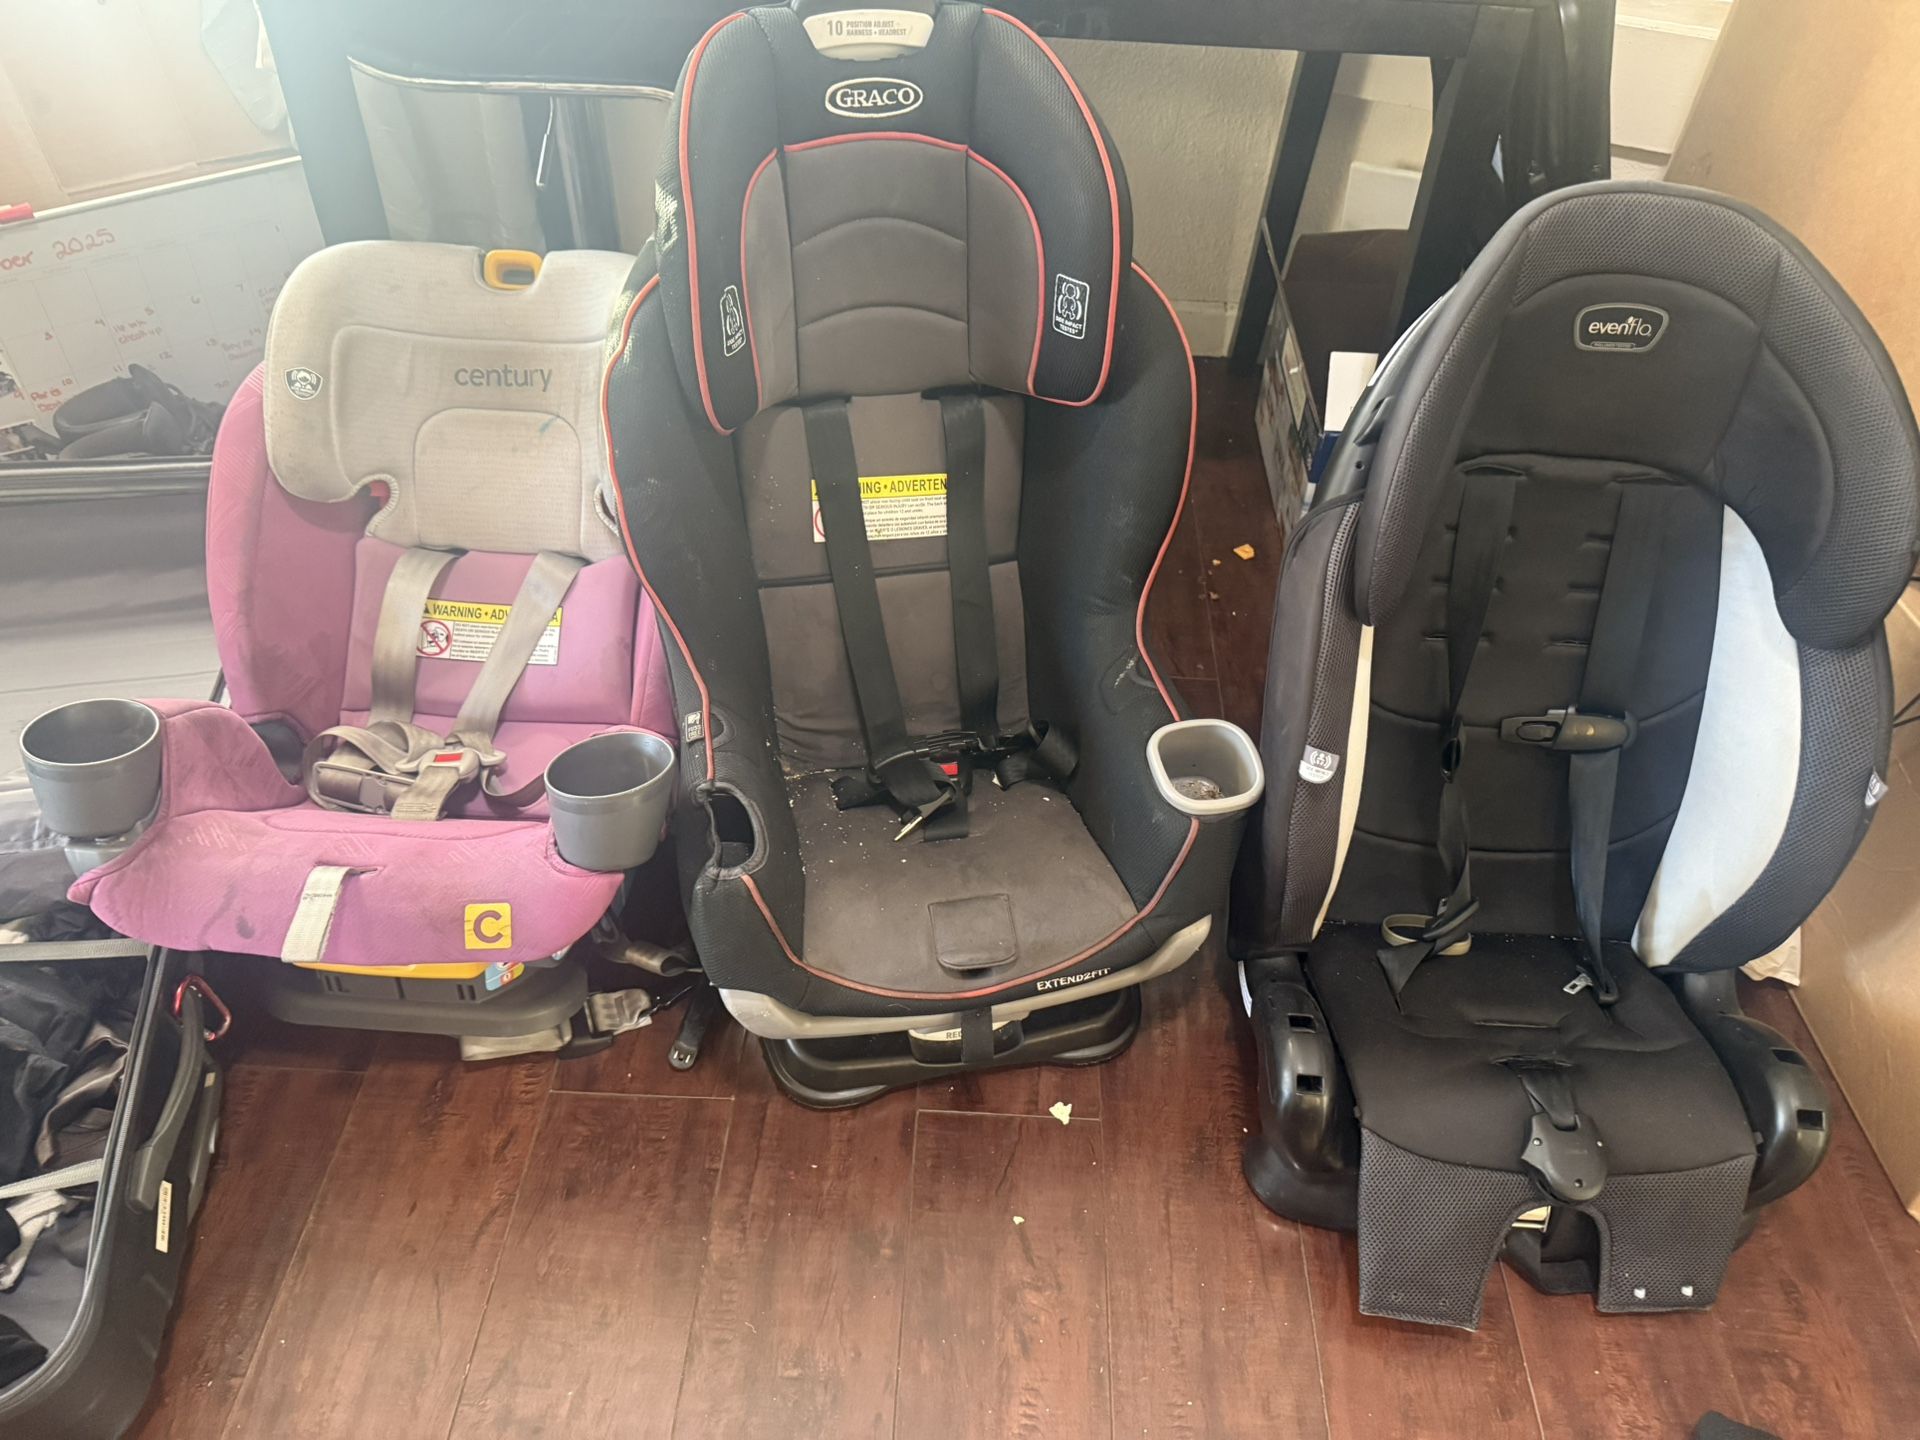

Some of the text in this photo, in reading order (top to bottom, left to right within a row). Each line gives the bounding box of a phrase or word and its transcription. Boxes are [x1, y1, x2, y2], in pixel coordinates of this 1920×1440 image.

[827, 20, 843, 36] 10
[846, 20, 894, 28] POSITION ADJUST
[846, 28, 872, 36] HARNESS
[878, 28, 907, 36] HEADREST
[836, 87, 915, 108] GRACO
[52, 228, 115, 260] 2025
[1588, 316, 1652, 337] evenflo
[454, 363, 552, 393] century
[889, 478, 947, 493] ADVERTEN
[433, 603, 482, 619] WARNING
[1036, 967, 1111, 991] EXTEND2FIT
